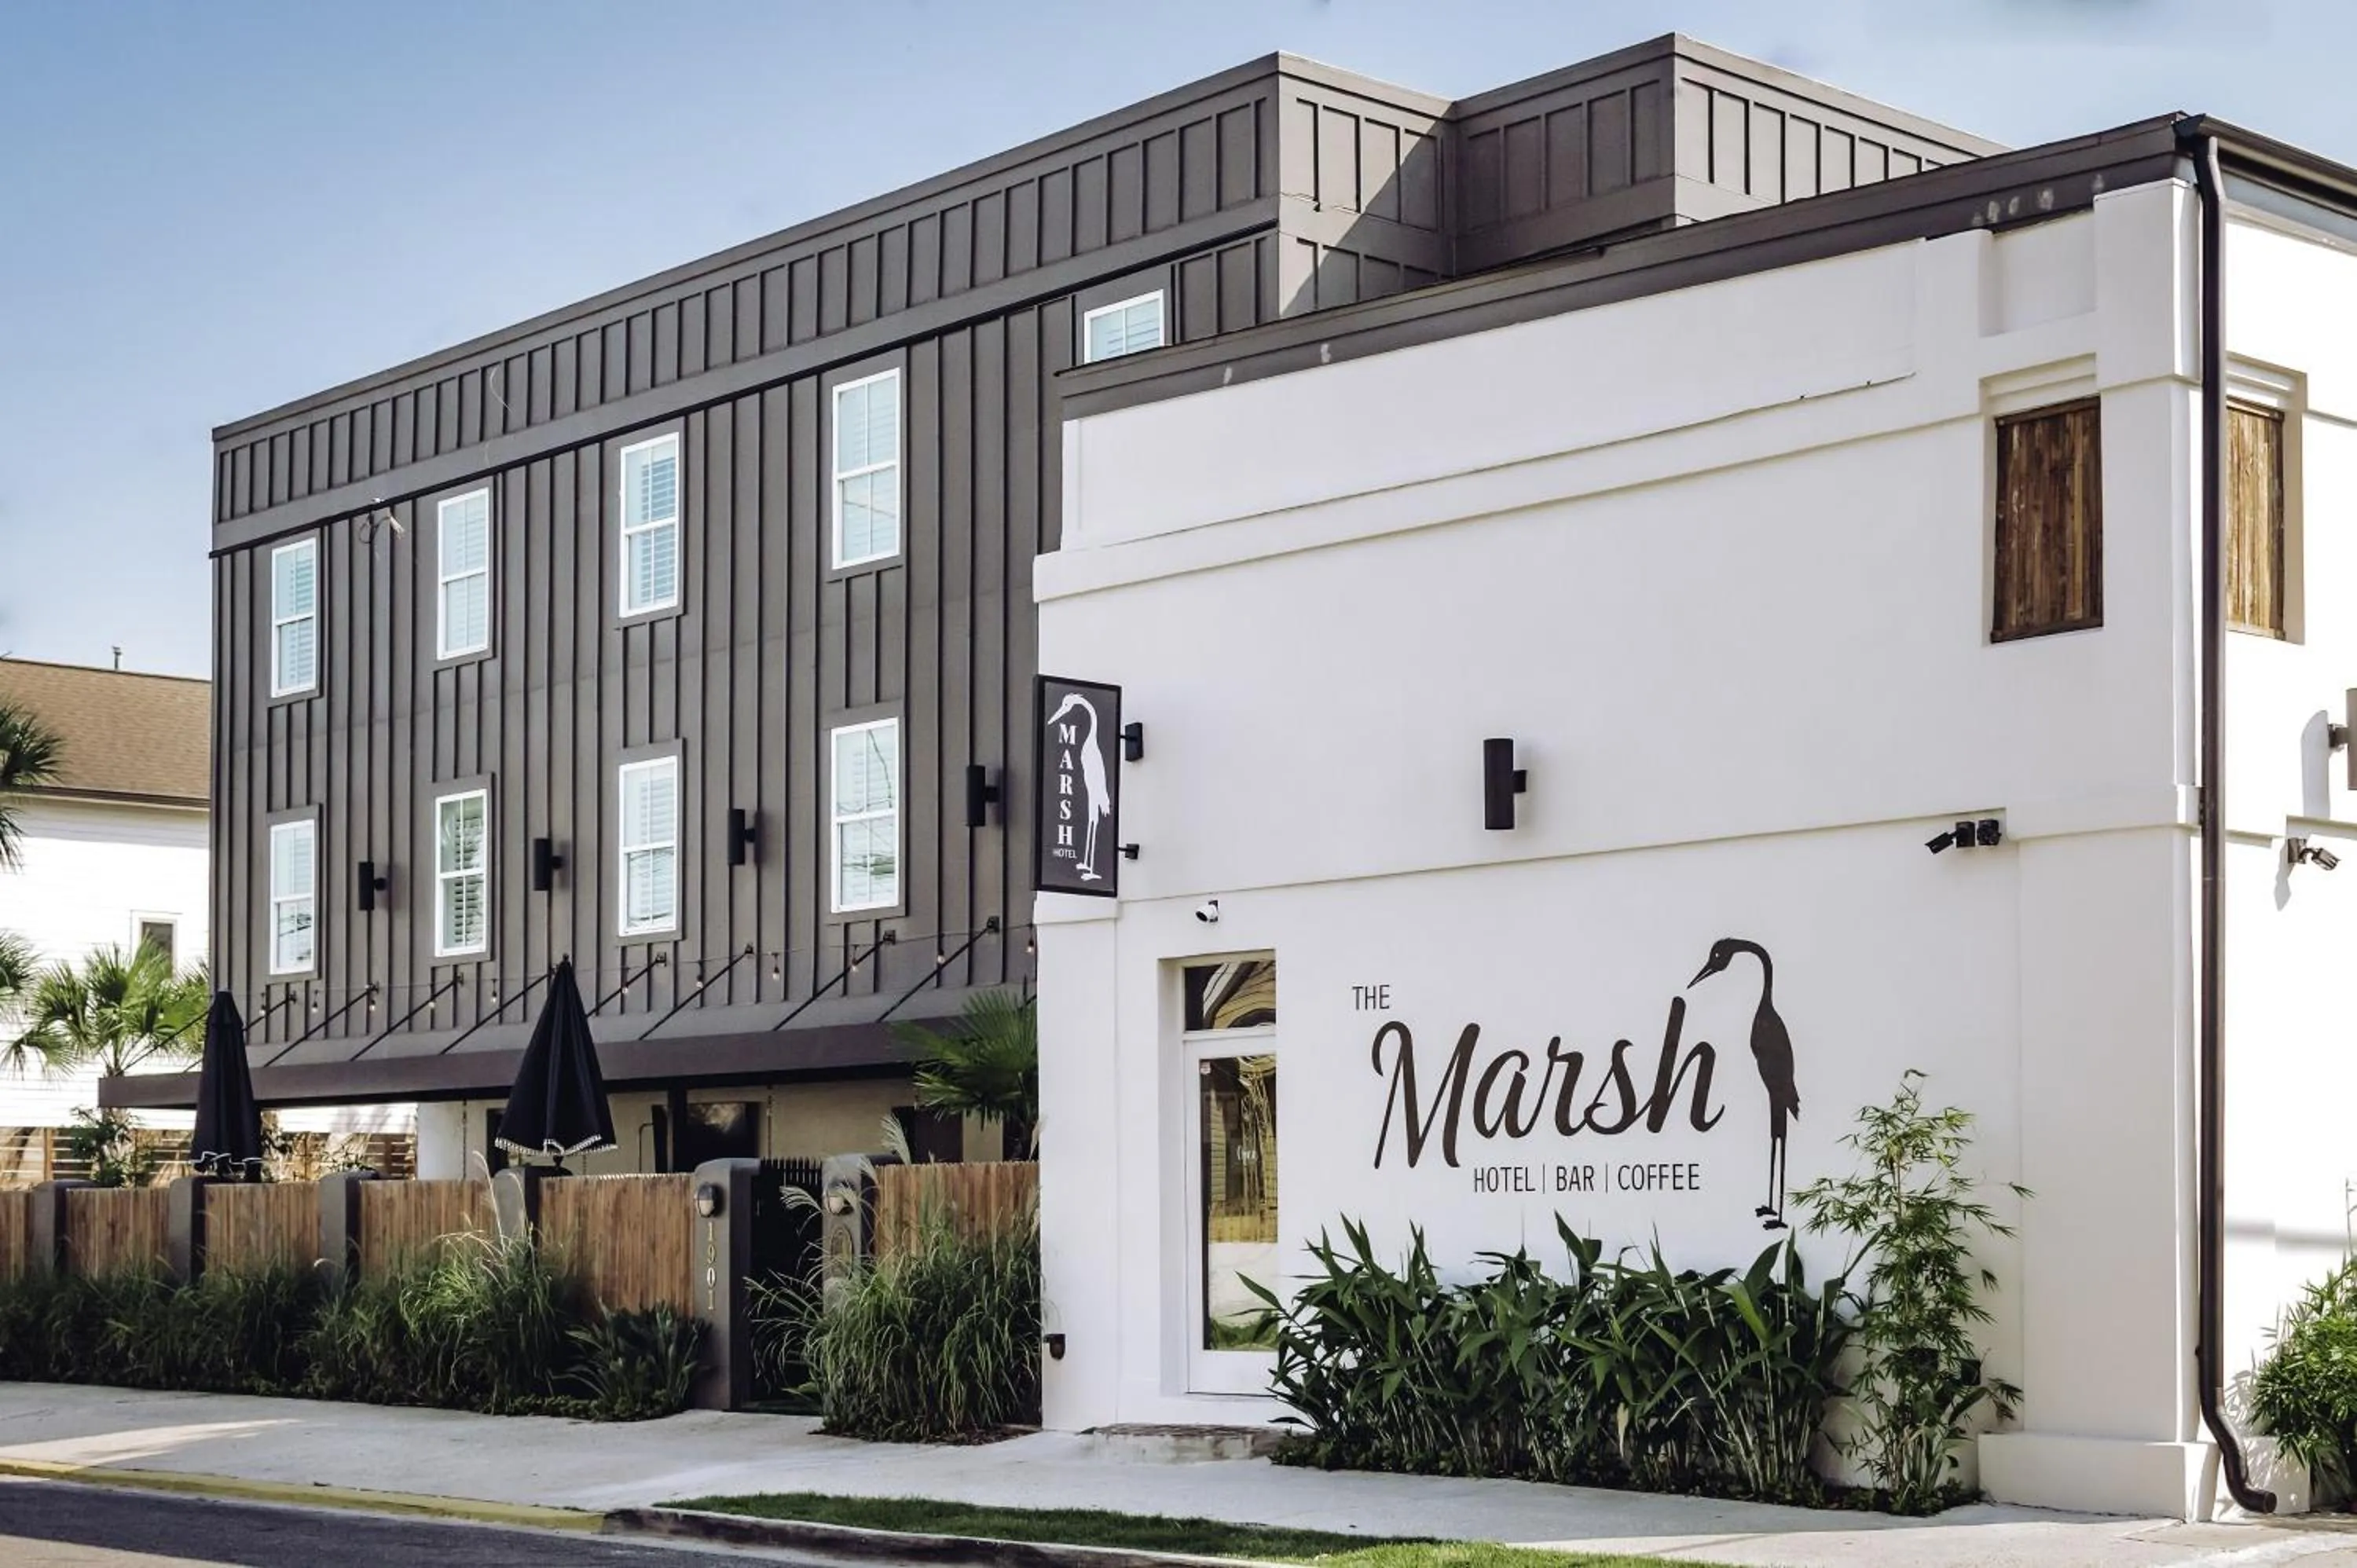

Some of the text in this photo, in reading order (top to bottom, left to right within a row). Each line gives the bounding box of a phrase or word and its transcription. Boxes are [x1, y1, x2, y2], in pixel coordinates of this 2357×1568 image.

[1058, 723, 1077, 846] MARSH
[1053, 848, 1077, 859] HOTEL
[1352, 985, 1390, 1010] THE
[1371, 995, 1725, 1170] Marsh
[1474, 1163, 1700, 1193] HOTEL BAR COFFEE
